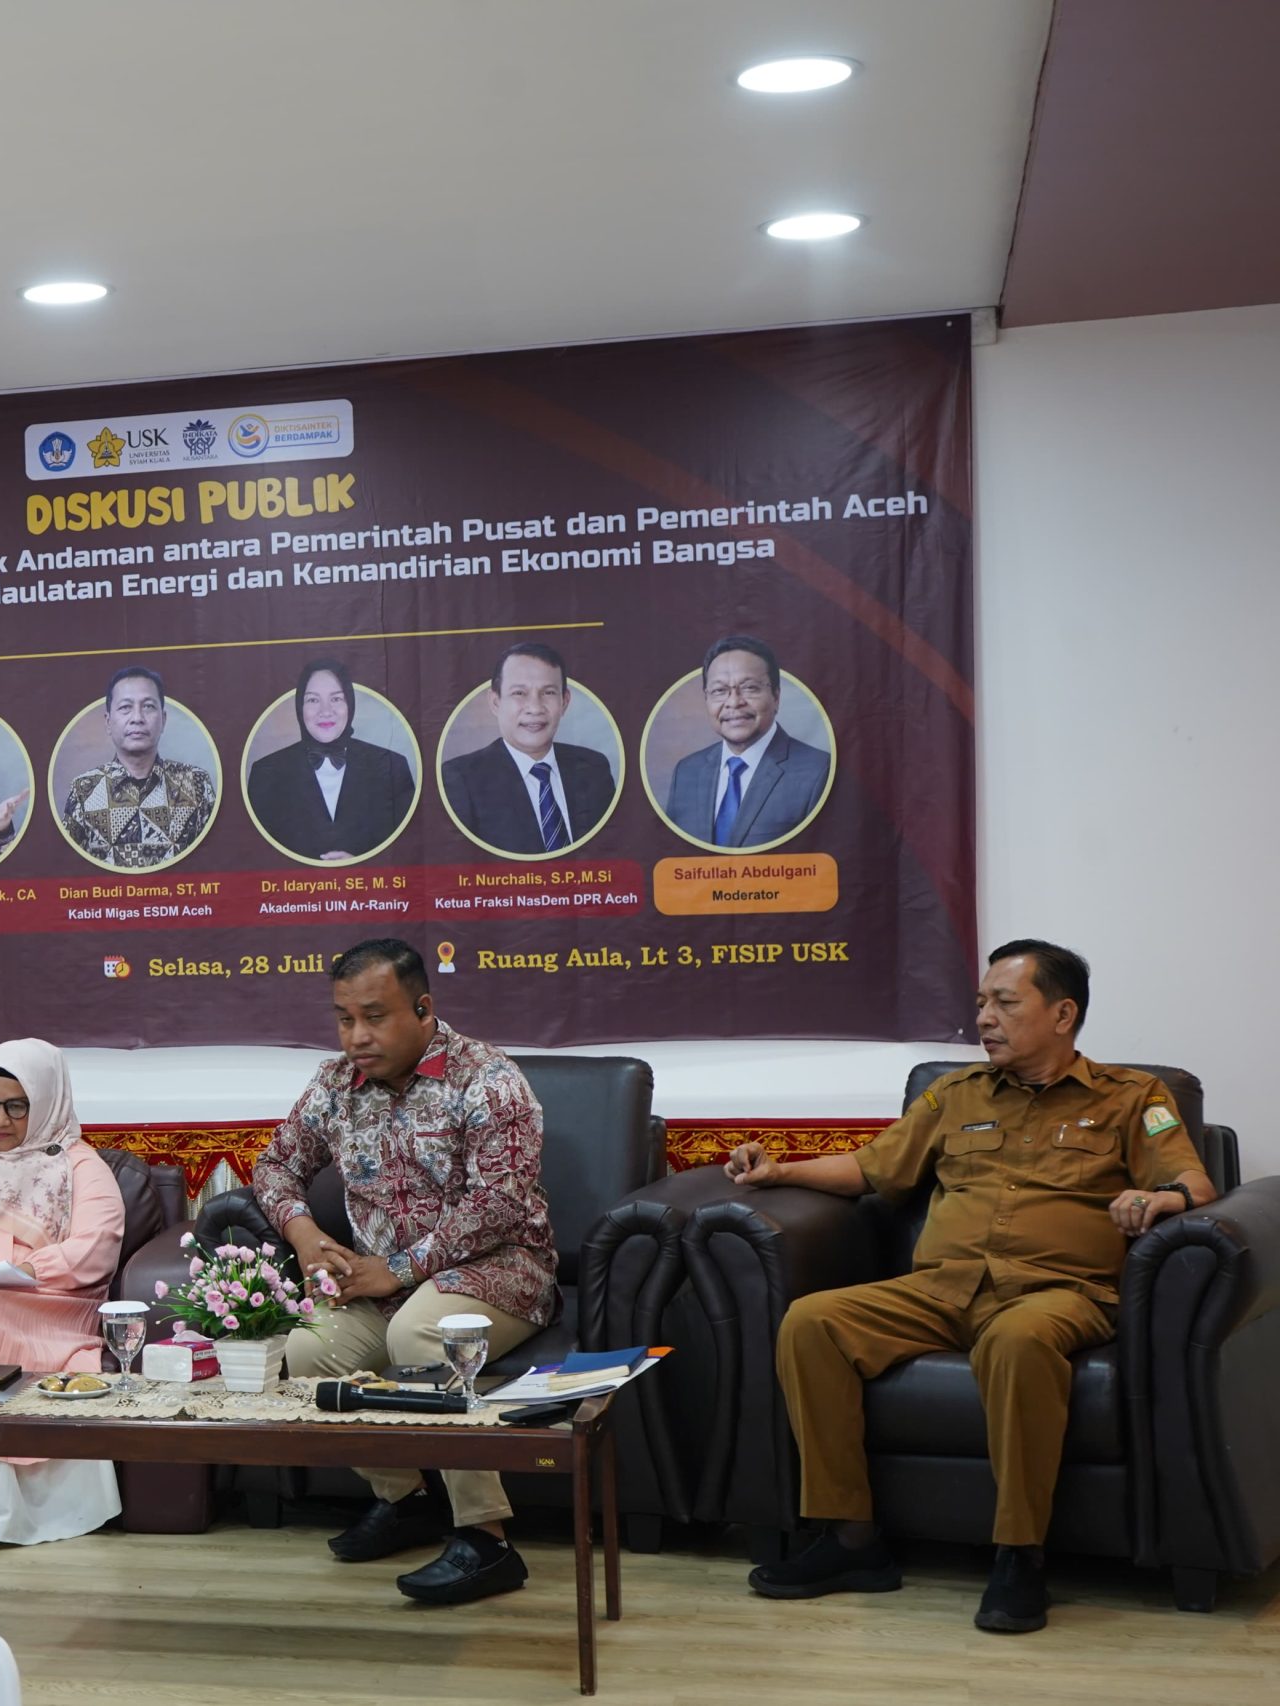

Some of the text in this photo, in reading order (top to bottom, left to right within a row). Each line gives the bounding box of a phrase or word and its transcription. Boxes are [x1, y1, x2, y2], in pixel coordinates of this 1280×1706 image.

[274, 421, 332, 433] DIKTISAINTEK
[126, 428, 169, 448] USK
[274, 431, 333, 442] BERDAMPAK
[129, 450, 170, 458] UNIVERSITAS
[27, 474, 355, 534] DISKUSI PUBLIK
[16, 546, 153, 571] Andaman
[164, 538, 260, 561] antara
[271, 522, 451, 554] Pemerintah
[463, 516, 556, 542] Pusat
[567, 512, 625, 535] dan
[638, 497, 832, 531] Pemerintah
[843, 491, 927, 518] Aceh
[123, 569, 217, 596] Energi
[228, 567, 283, 589] dan
[294, 554, 490, 585] Kemandirian
[502, 542, 640, 573] Ekonomi
[653, 539, 775, 565] Bangsa
[459, 871, 611, 886] Ir. Nurchalis, S.P.,M.Si
[675, 865, 816, 880] Saifullah Abdulgani
[60, 883, 220, 898] Dian Budi Darma, ST, MT
[262, 877, 405, 893] Dr. Idaryani, SE, M. Si
[17, 889, 36, 900] CA
[436, 893, 637, 908] Ketua Fraksi NasDem DPR Aceh
[713, 890, 779, 900] Moderator
[69, 905, 212, 920] Kabid Migas ESDM Aceh
[260, 899, 408, 913] Akademisi UIN Ar-Raniry
[478, 943, 848, 972] Ruang Aula, Lt 3, FISIP USK
[149, 958, 231, 978] Selasa,
[240, 956, 269, 974] 28
[278, 954, 323, 973] Juli
